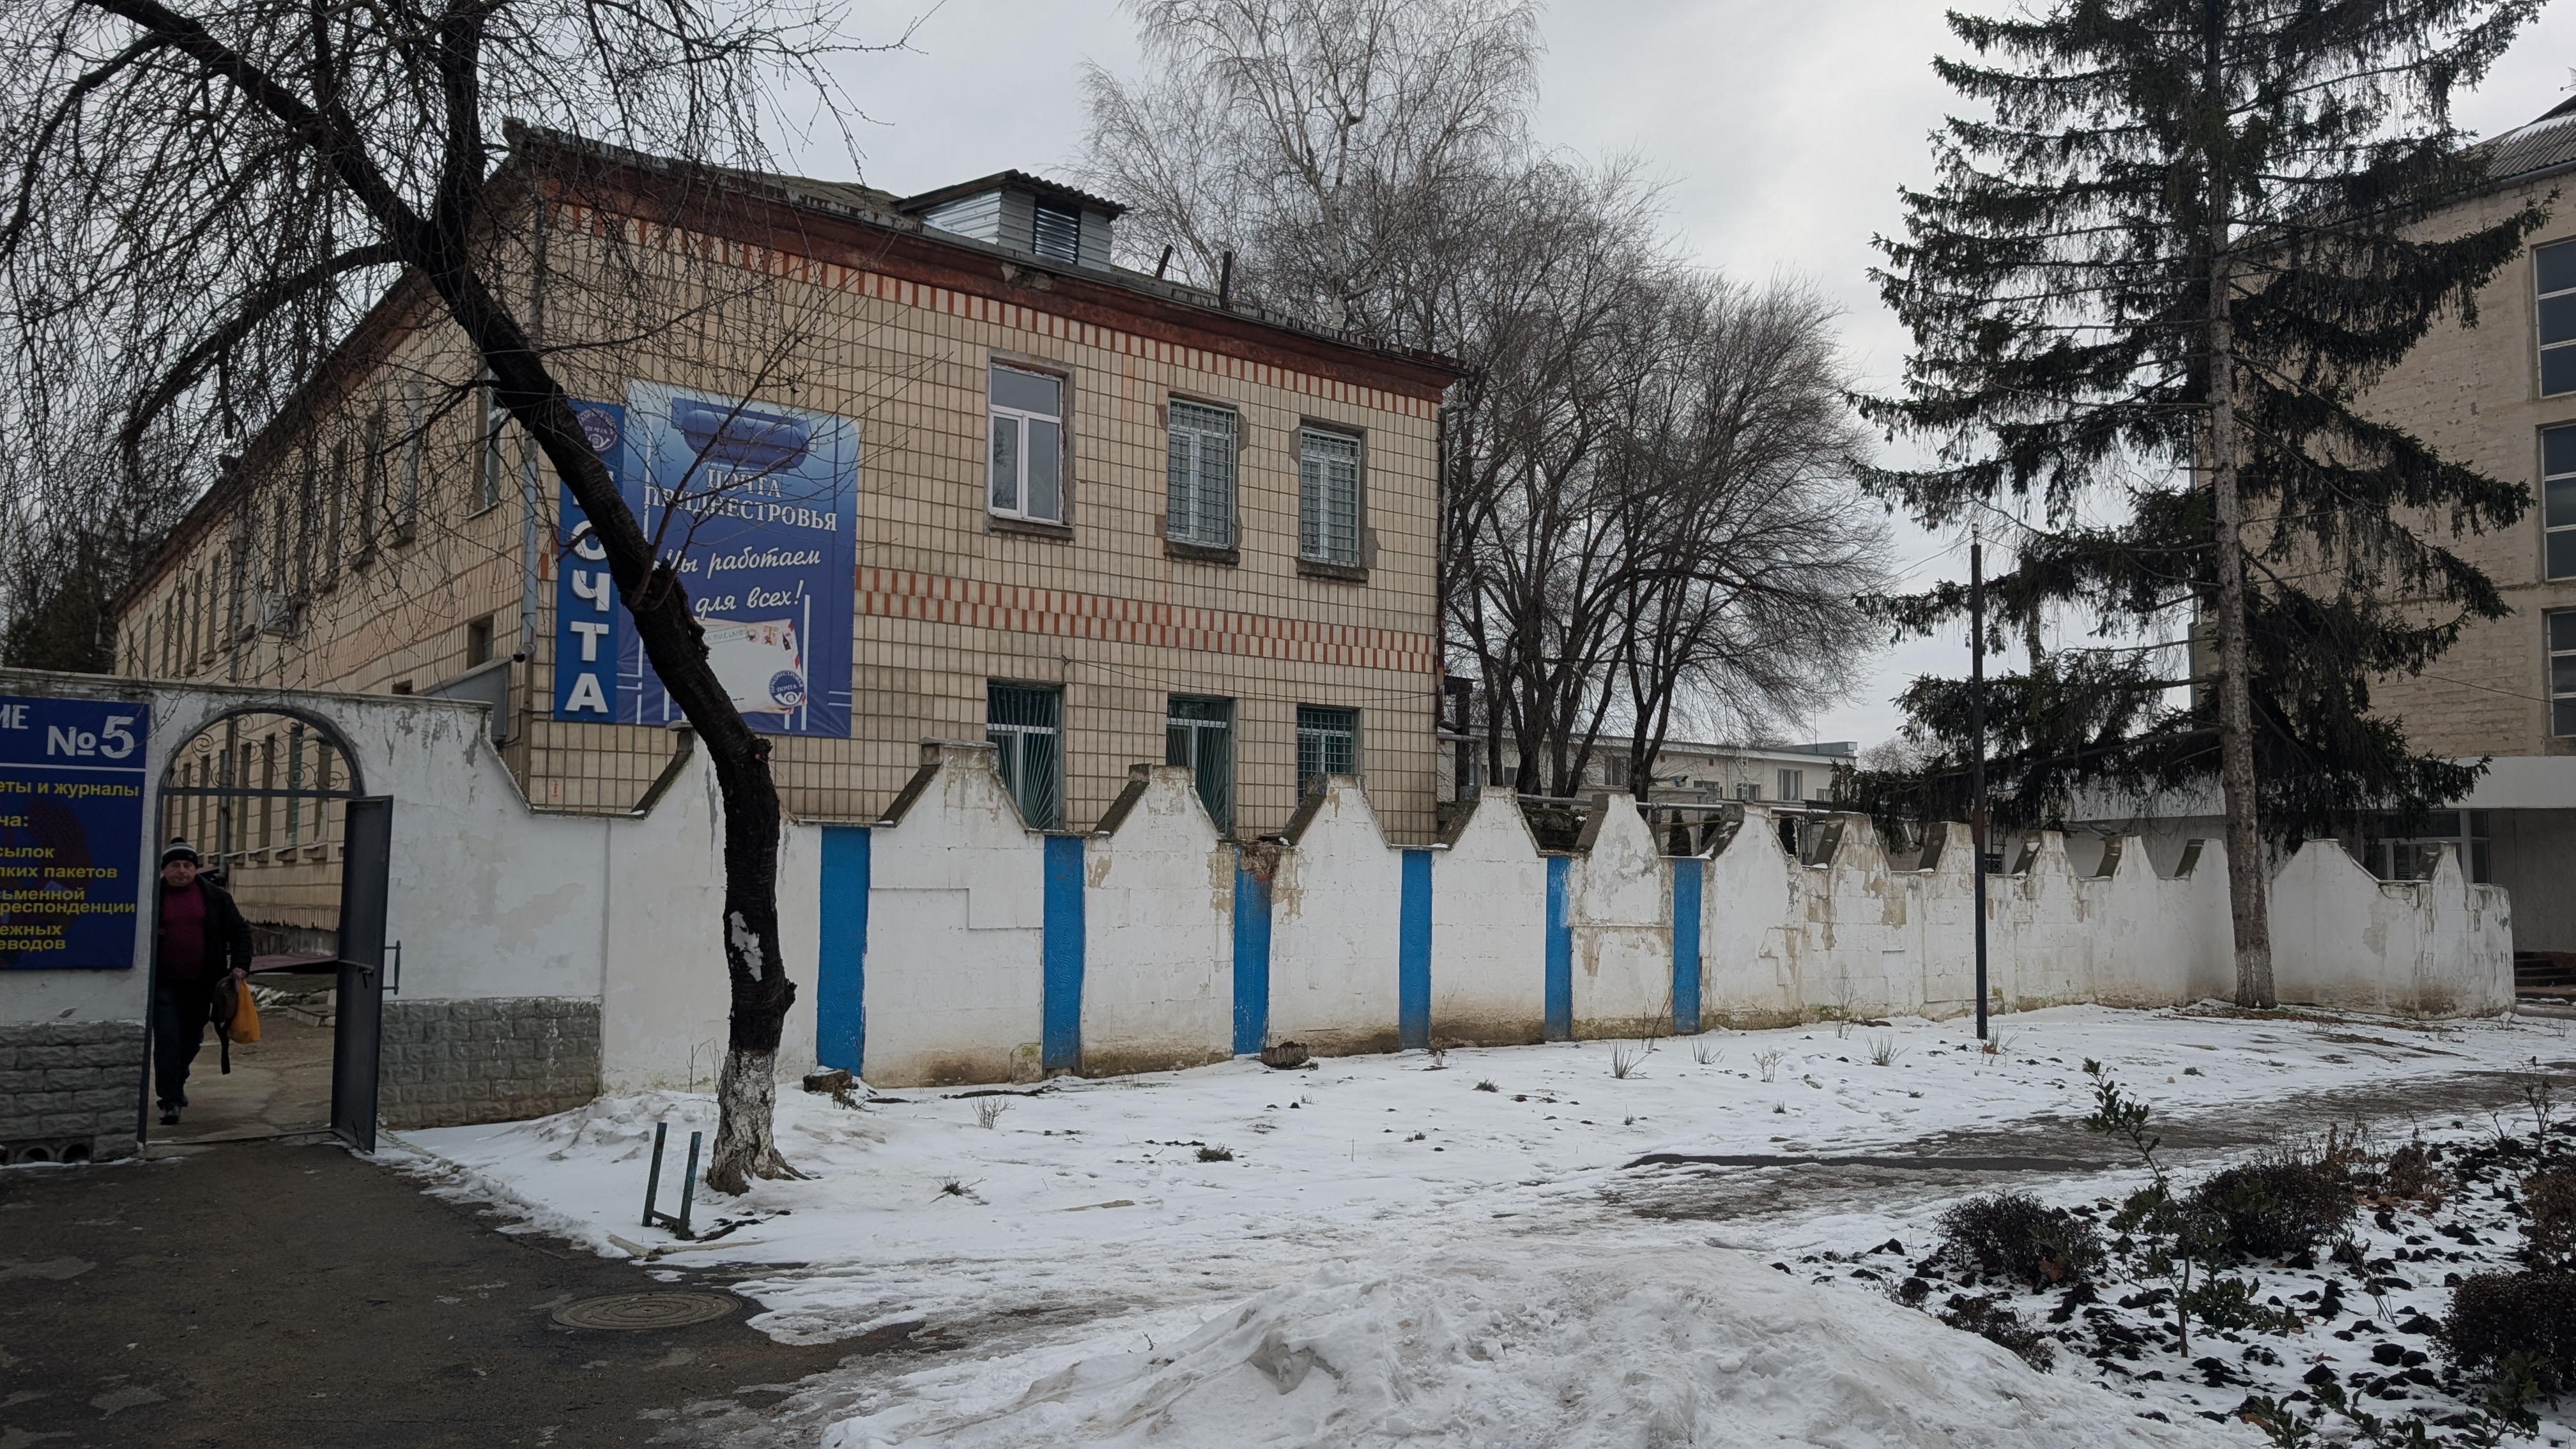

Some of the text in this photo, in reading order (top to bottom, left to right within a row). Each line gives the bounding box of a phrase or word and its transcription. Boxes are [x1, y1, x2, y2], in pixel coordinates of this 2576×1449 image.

[707, 468, 782, 498] ПОЧТА
[707, 546, 821, 579] работаем
[695, 579, 804, 620] для всех!
[38, 783, 49, 794] и
[54, 783, 139, 799] журналы
[44, 867, 118, 878] пакетов
